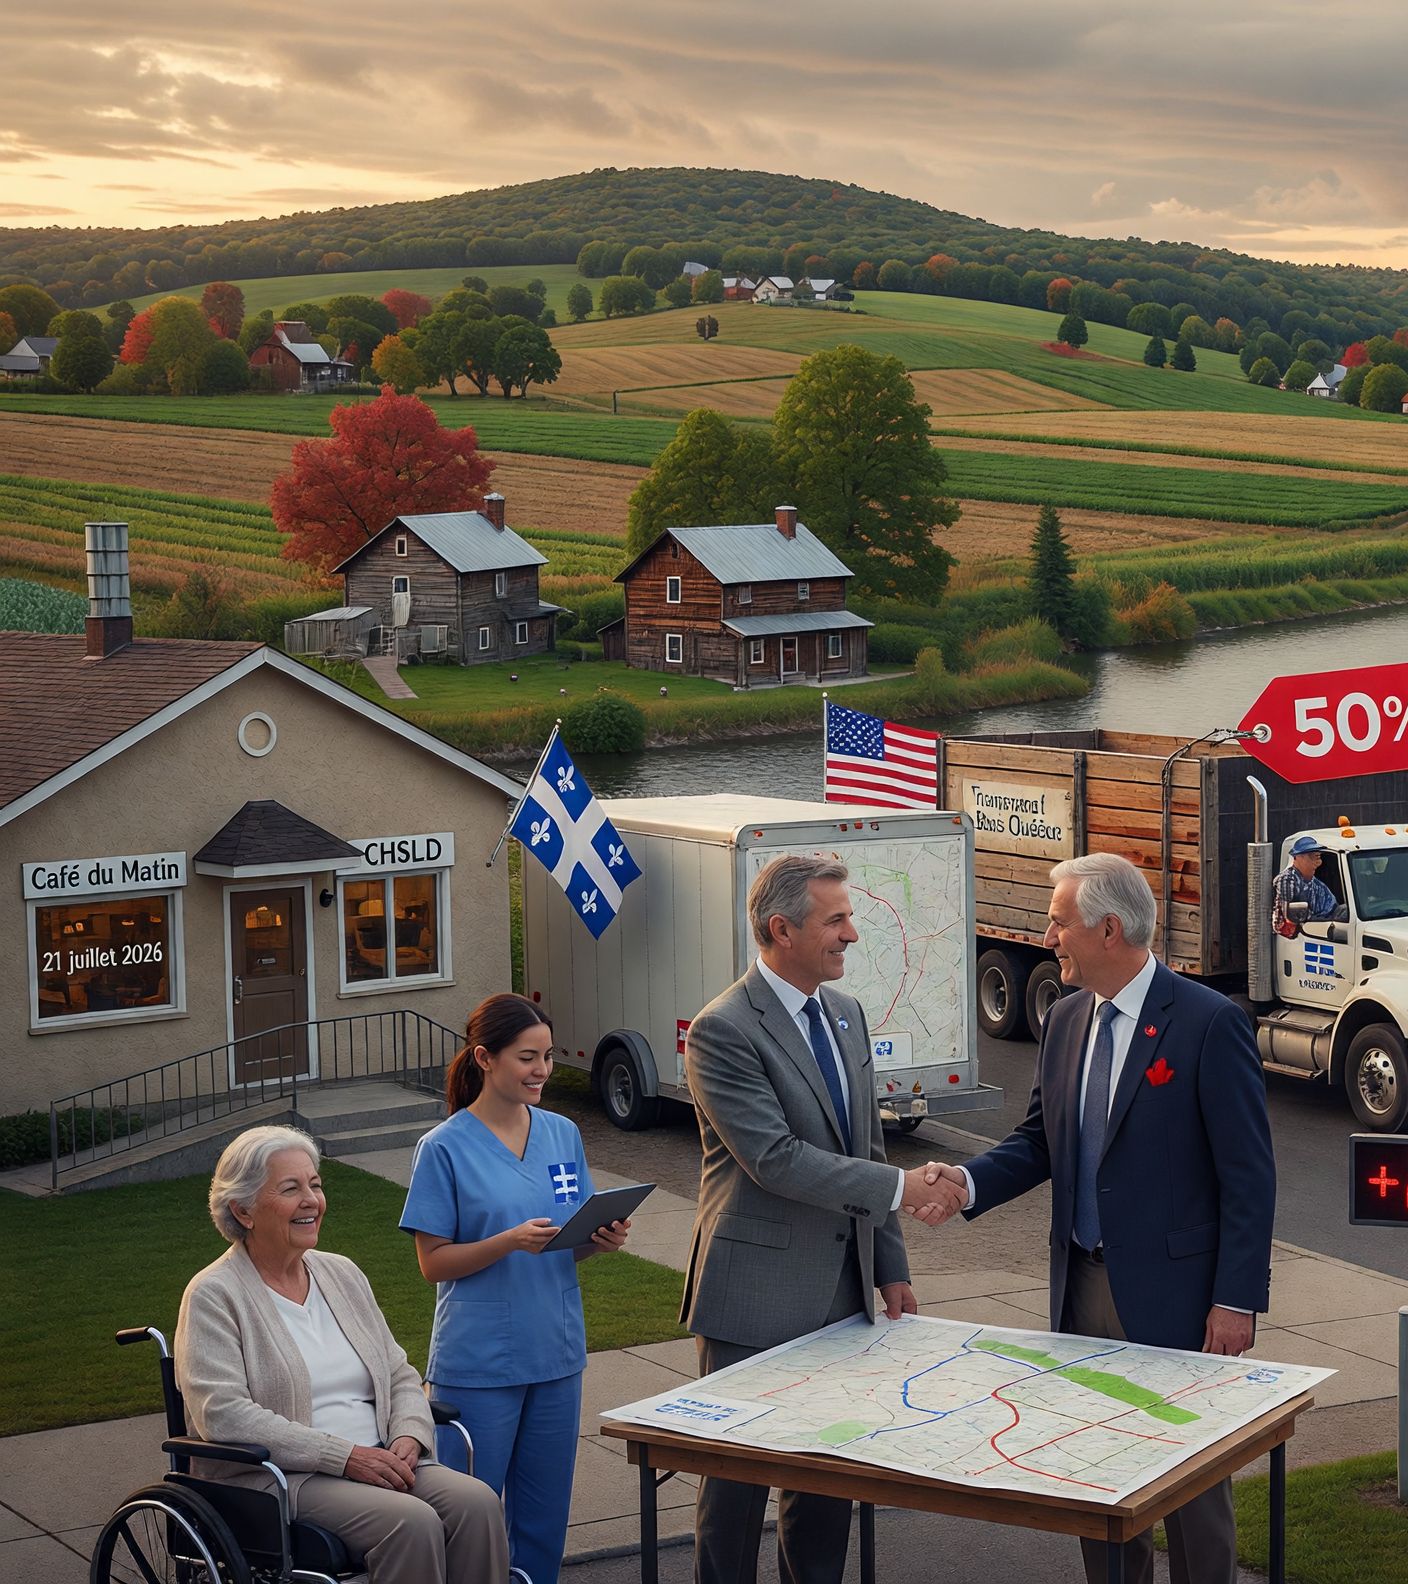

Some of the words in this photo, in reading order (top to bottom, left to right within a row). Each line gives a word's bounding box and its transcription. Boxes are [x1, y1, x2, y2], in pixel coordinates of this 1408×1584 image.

[364, 838, 442, 866] CHSLD
[31, 864, 80, 890] Café
[88, 862, 113, 886] du
[121, 858, 179, 883] Matin
[42, 951, 61, 972] 21
[67, 947, 118, 976] juillet
[122, 941, 163, 966] 2026
